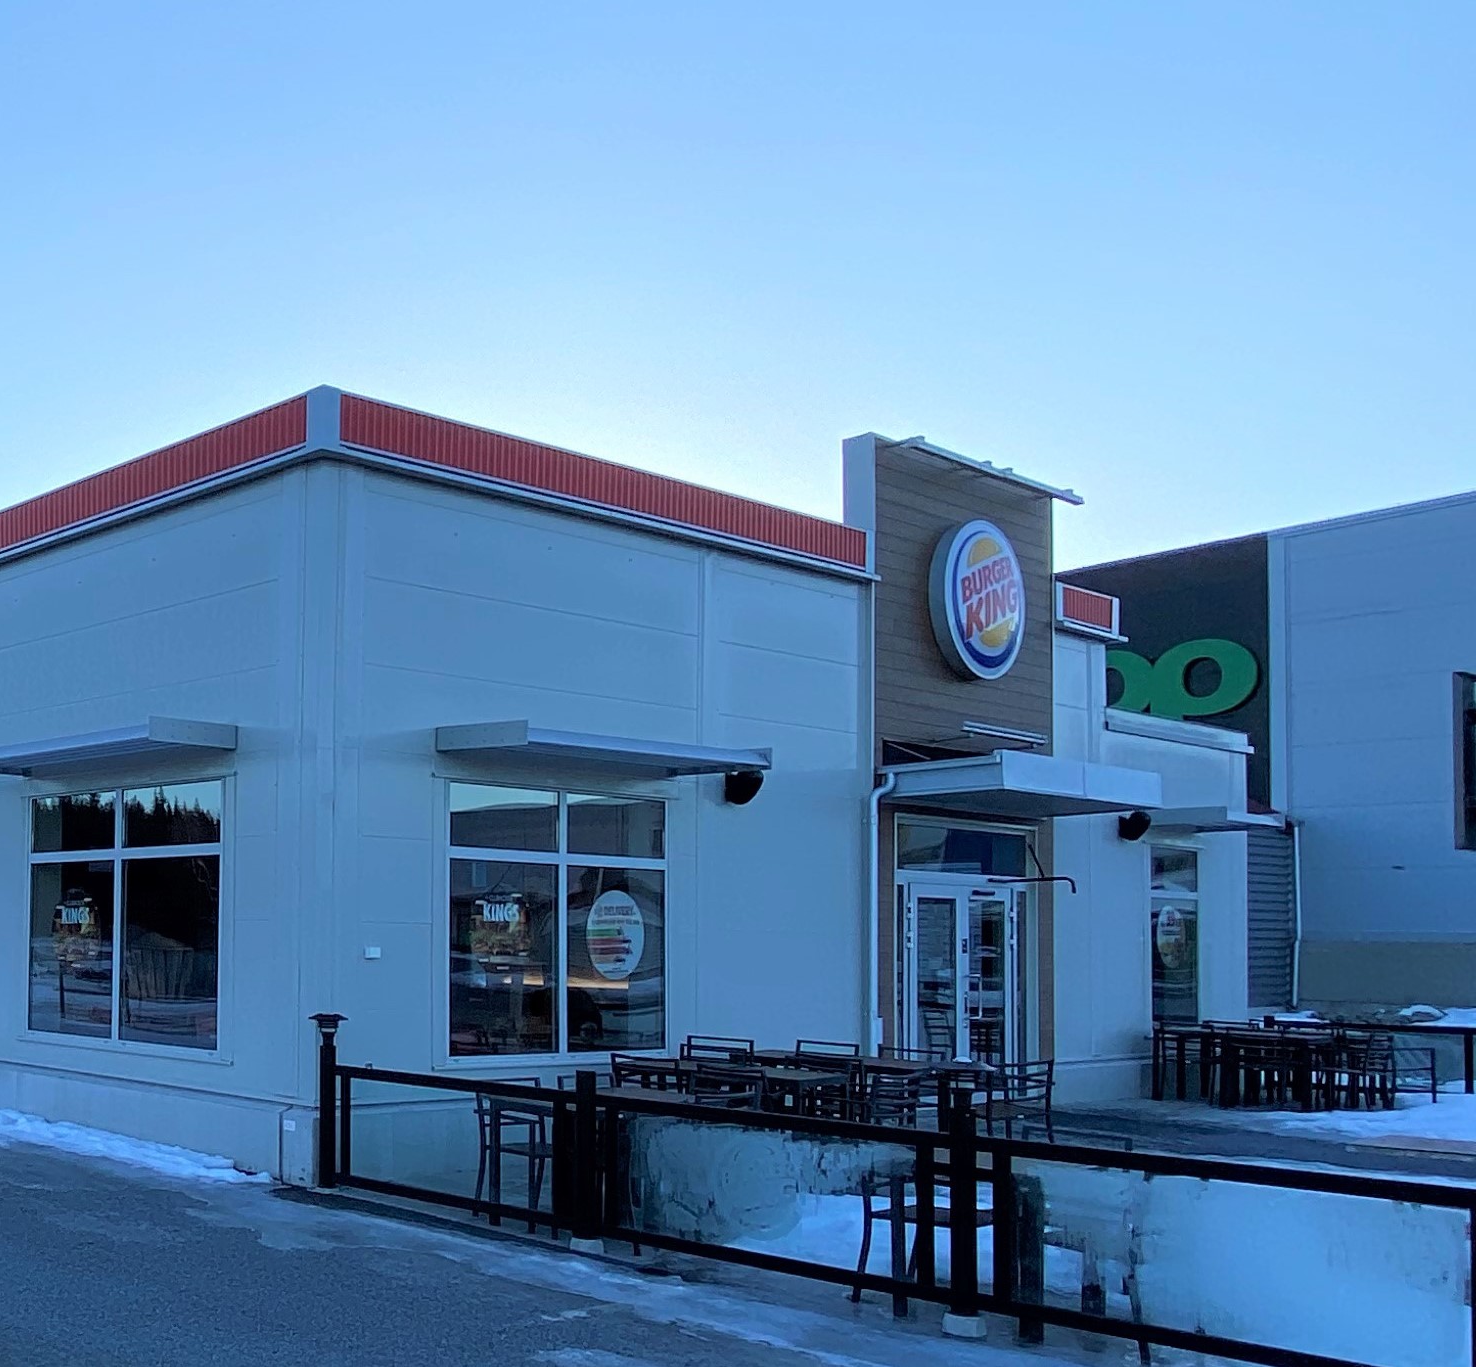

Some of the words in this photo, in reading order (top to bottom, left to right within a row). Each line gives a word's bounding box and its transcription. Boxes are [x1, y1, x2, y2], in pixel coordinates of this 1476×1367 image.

[961, 556, 1013, 604] BURGER
[966, 578, 1017, 640] KING
[483, 902, 520, 922] KINGS
